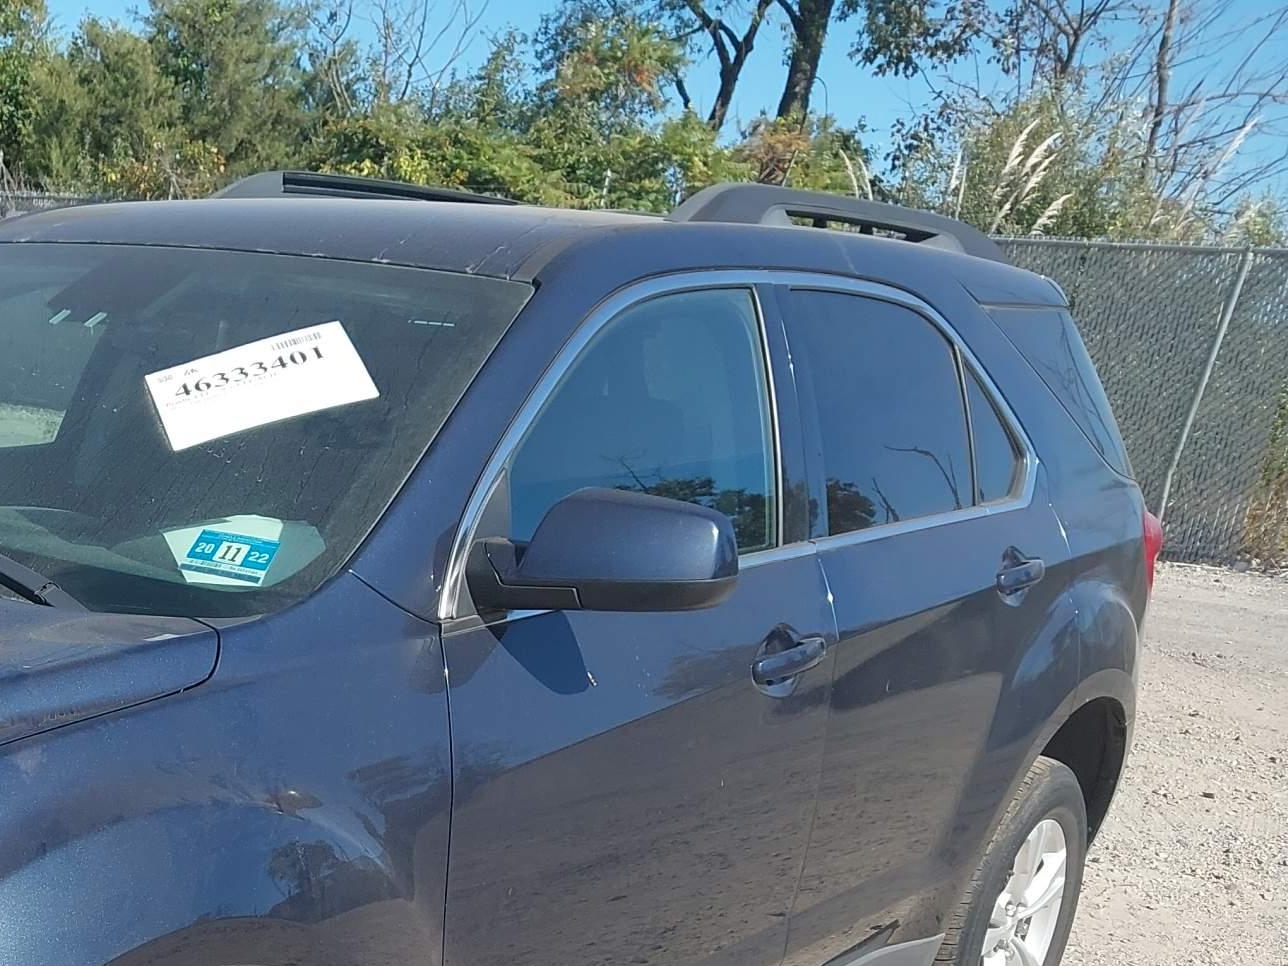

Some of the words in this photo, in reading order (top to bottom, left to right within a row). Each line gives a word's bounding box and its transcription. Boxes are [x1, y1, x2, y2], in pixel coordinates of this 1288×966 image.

[175, 345, 324, 397] 46333401
[194, 542, 216, 554] 20
[218, 545, 242, 563] 11
[248, 551, 270, 564] 22
